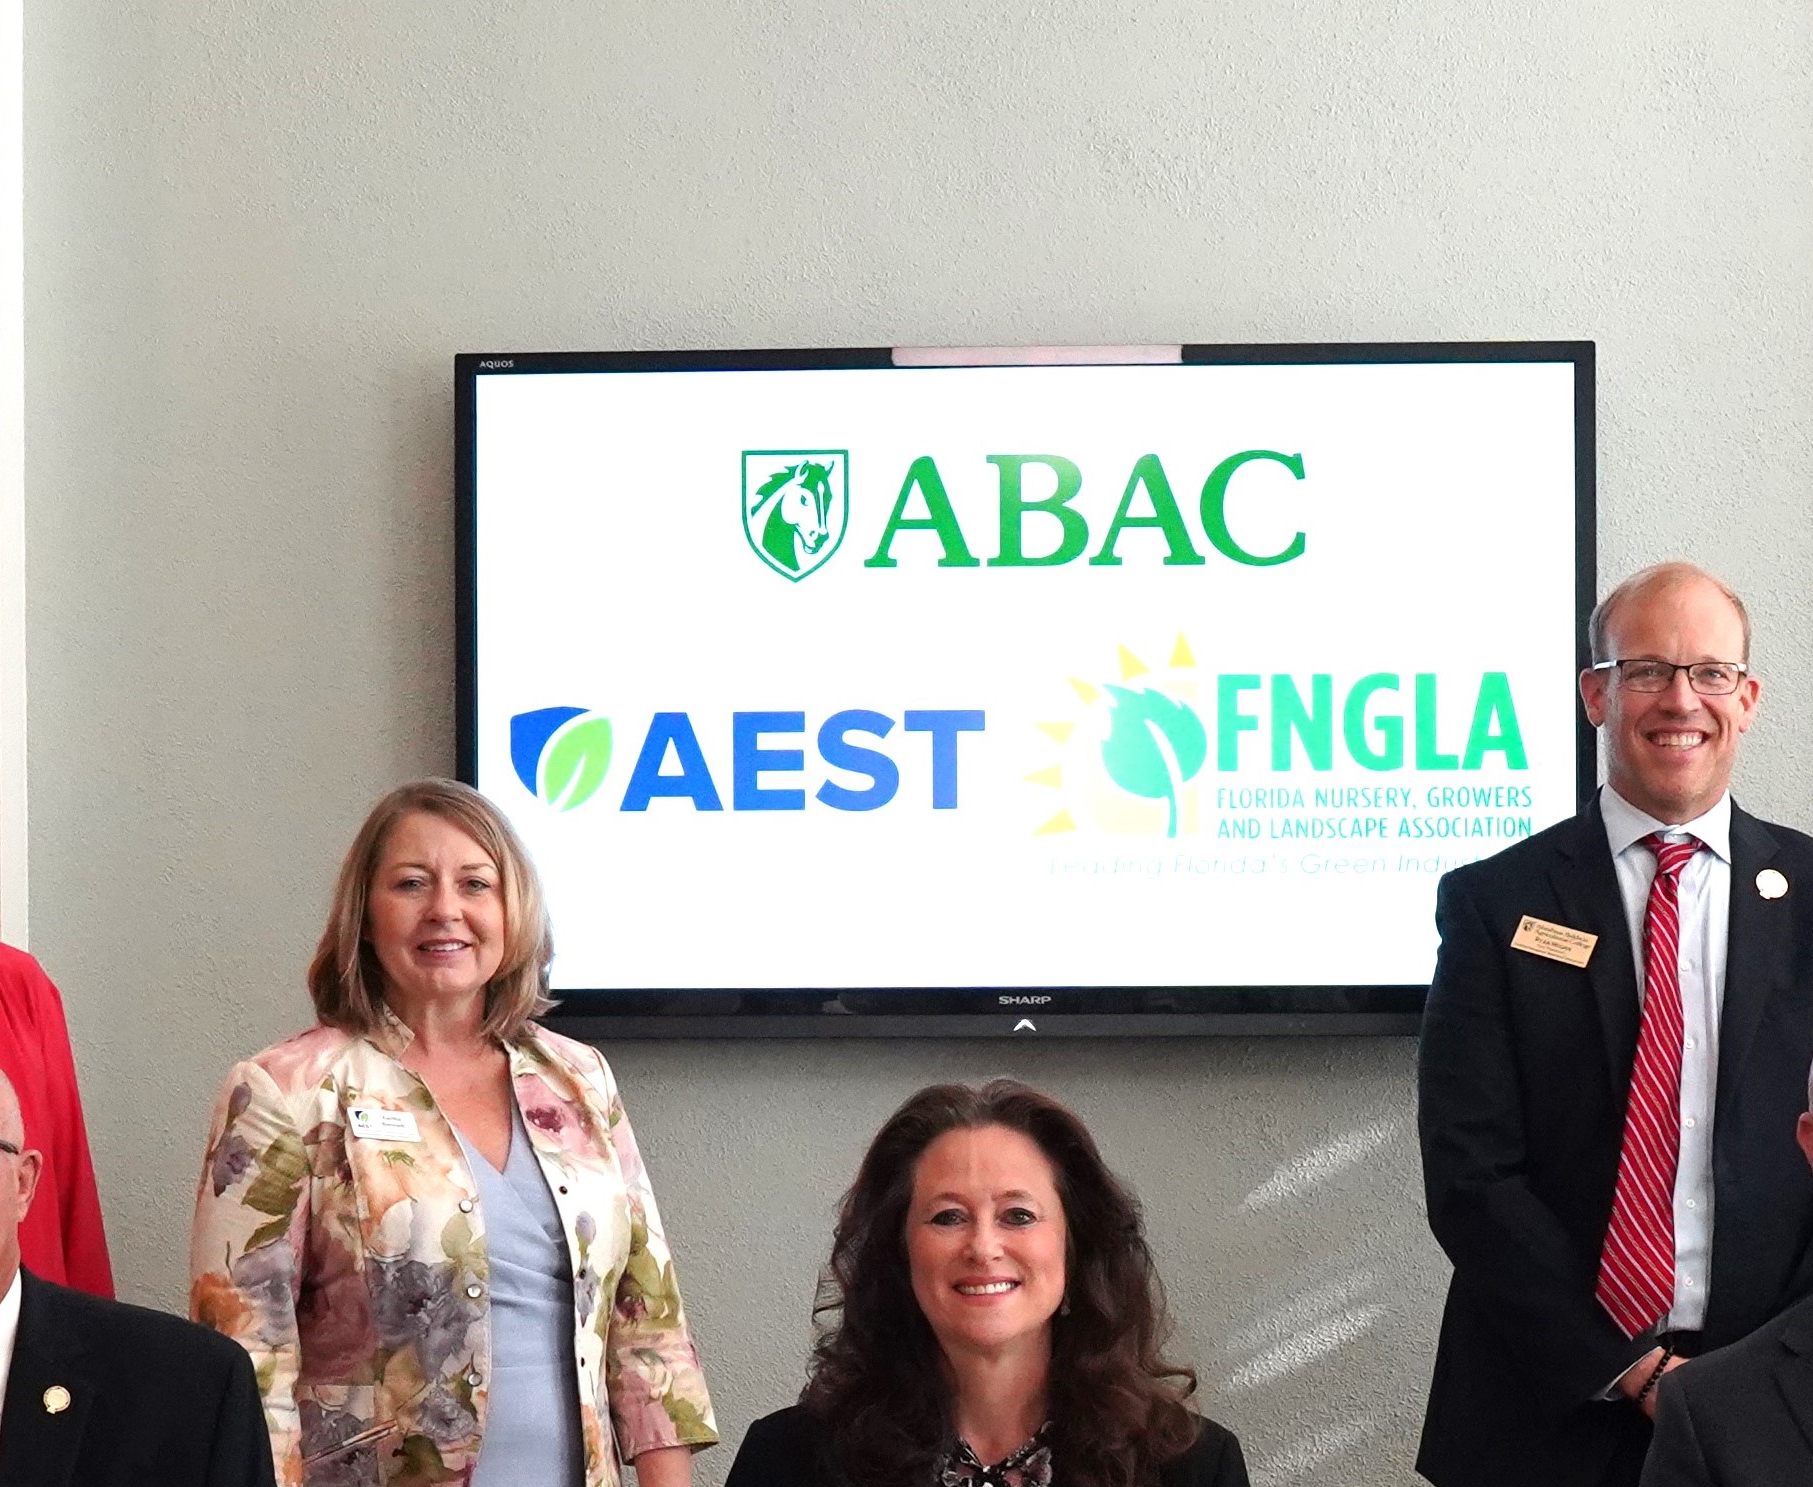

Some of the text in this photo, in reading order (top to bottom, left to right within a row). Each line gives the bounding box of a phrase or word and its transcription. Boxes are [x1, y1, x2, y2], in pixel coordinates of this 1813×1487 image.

[479, 360, 514, 369] AQUOS
[864, 450, 1306, 568] ABAC
[1217, 672, 1529, 772] FNGLA
[619, 709, 986, 812] AEST
[1217, 786, 1532, 810] FLORIDA NURSERY, GROWERS
[1217, 815, 1532, 838] AND LANDSCAPE ASSOCIATION
[1051, 855, 1162, 879] Leading
[1300, 853, 1386, 875] Green
[999, 996, 1052, 1005] SHARP
